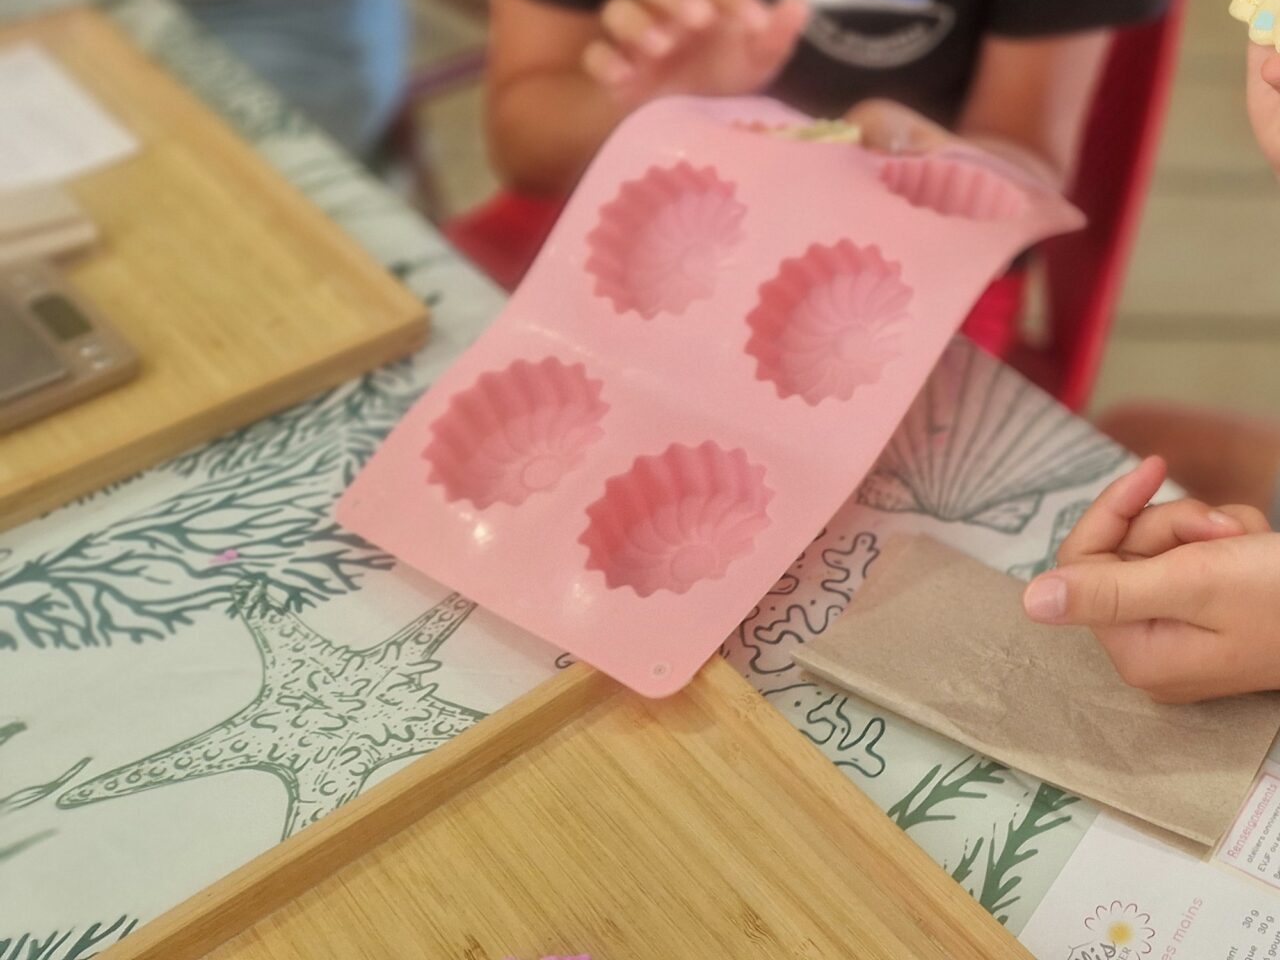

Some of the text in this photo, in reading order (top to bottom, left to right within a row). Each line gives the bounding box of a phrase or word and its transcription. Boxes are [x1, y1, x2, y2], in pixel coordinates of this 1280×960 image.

[1227, 783, 1278, 859] Renseignements
[1172, 897, 1203, 943] mains
[1242, 915, 1254, 929] 30
[1250, 909, 1260, 918] g
[1257, 922, 1269, 935] 30
[1265, 915, 1275, 923] g
